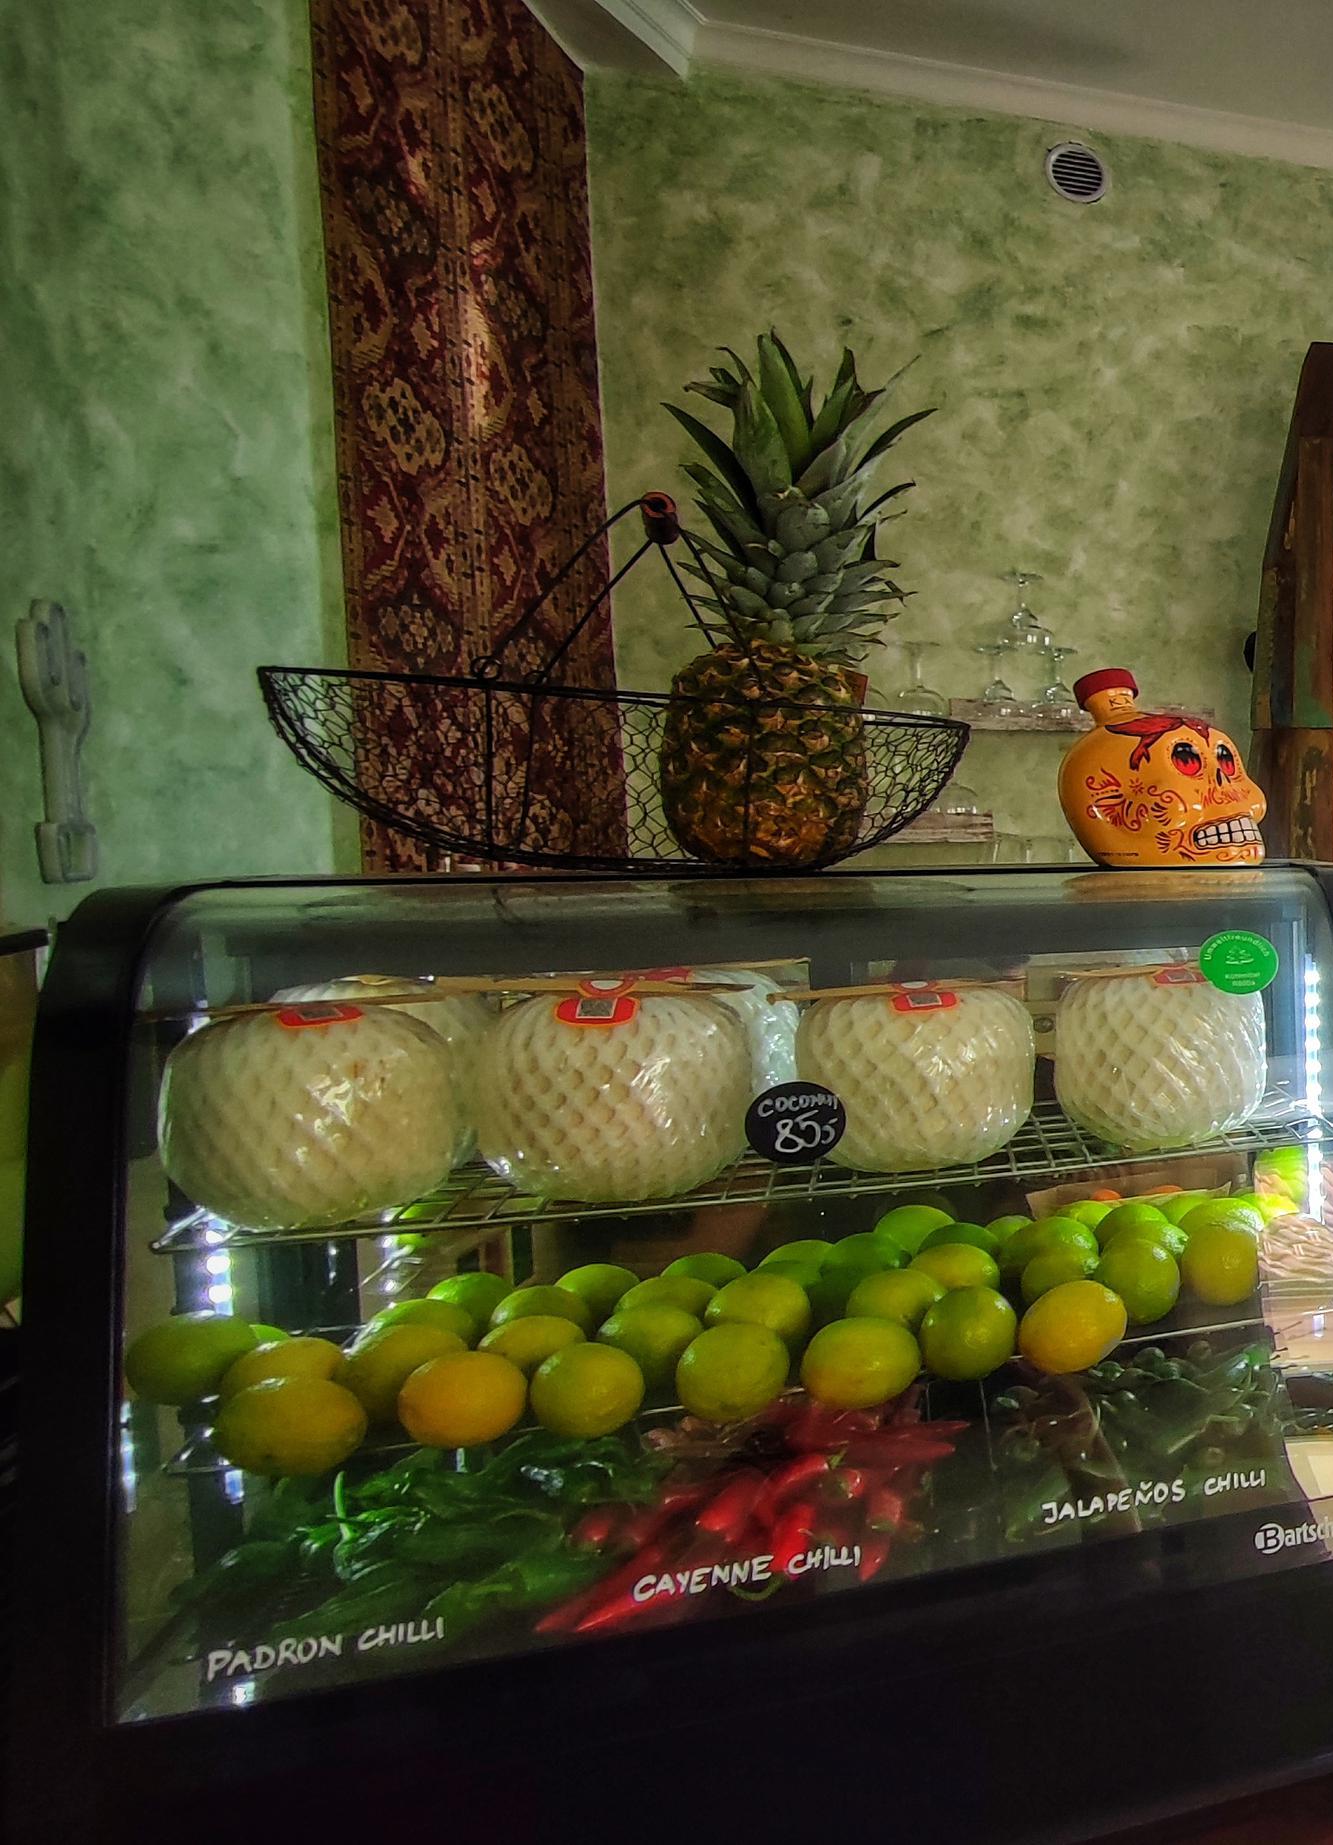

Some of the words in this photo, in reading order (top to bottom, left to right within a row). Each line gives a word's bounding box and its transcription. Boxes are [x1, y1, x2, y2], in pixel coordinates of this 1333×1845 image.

[1203, 1469, 1267, 1496] CHILLI
[632, 1554, 774, 1603] CAYENNE
[786, 1545, 861, 1575] CHILLI
[357, 1617, 445, 1651] CHILLI
